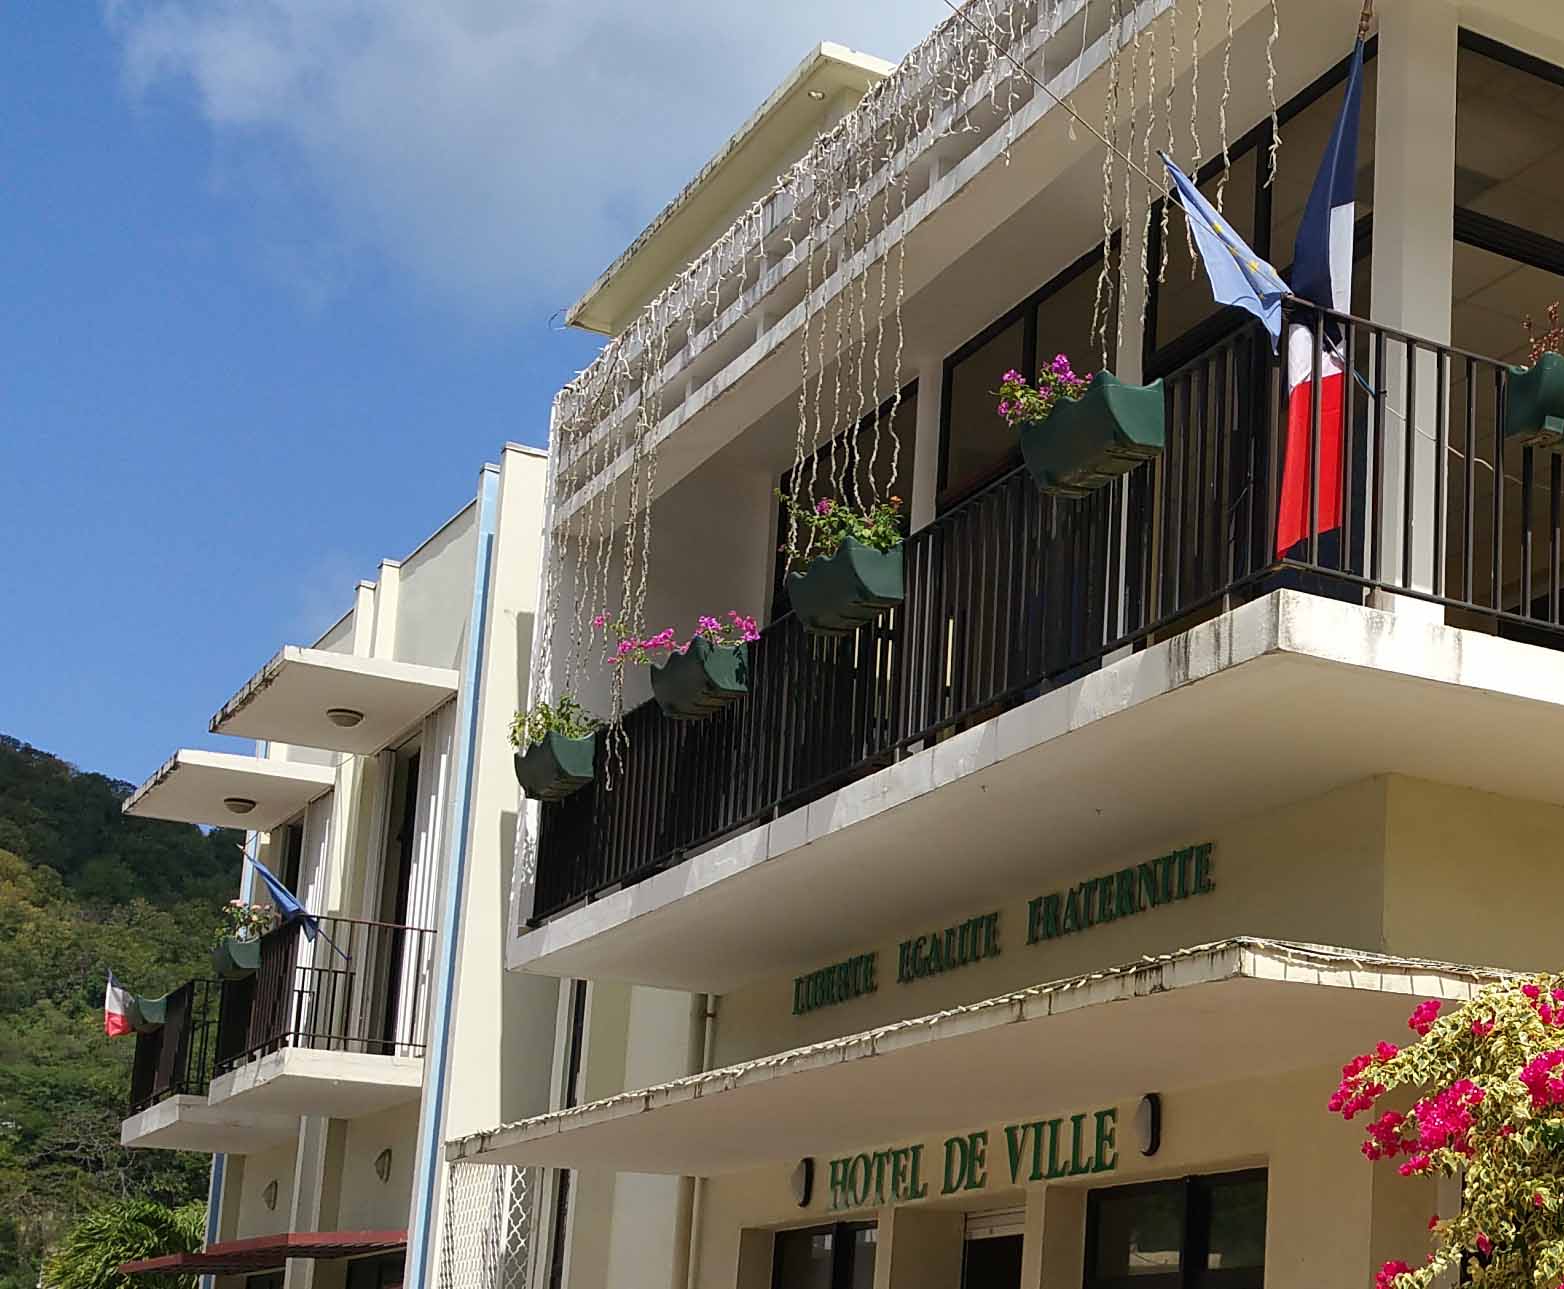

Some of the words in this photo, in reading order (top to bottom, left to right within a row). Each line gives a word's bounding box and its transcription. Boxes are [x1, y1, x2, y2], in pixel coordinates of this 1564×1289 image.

[792, 951, 878, 1015] LIBERTE
[897, 912, 1001, 983] EGALITE
[1026, 841, 1216, 945] FRATERNITE
[829, 1144, 927, 1209] HOTEL
[940, 1130, 988, 1195] DE
[1004, 1107, 1118, 1185] VILLE
